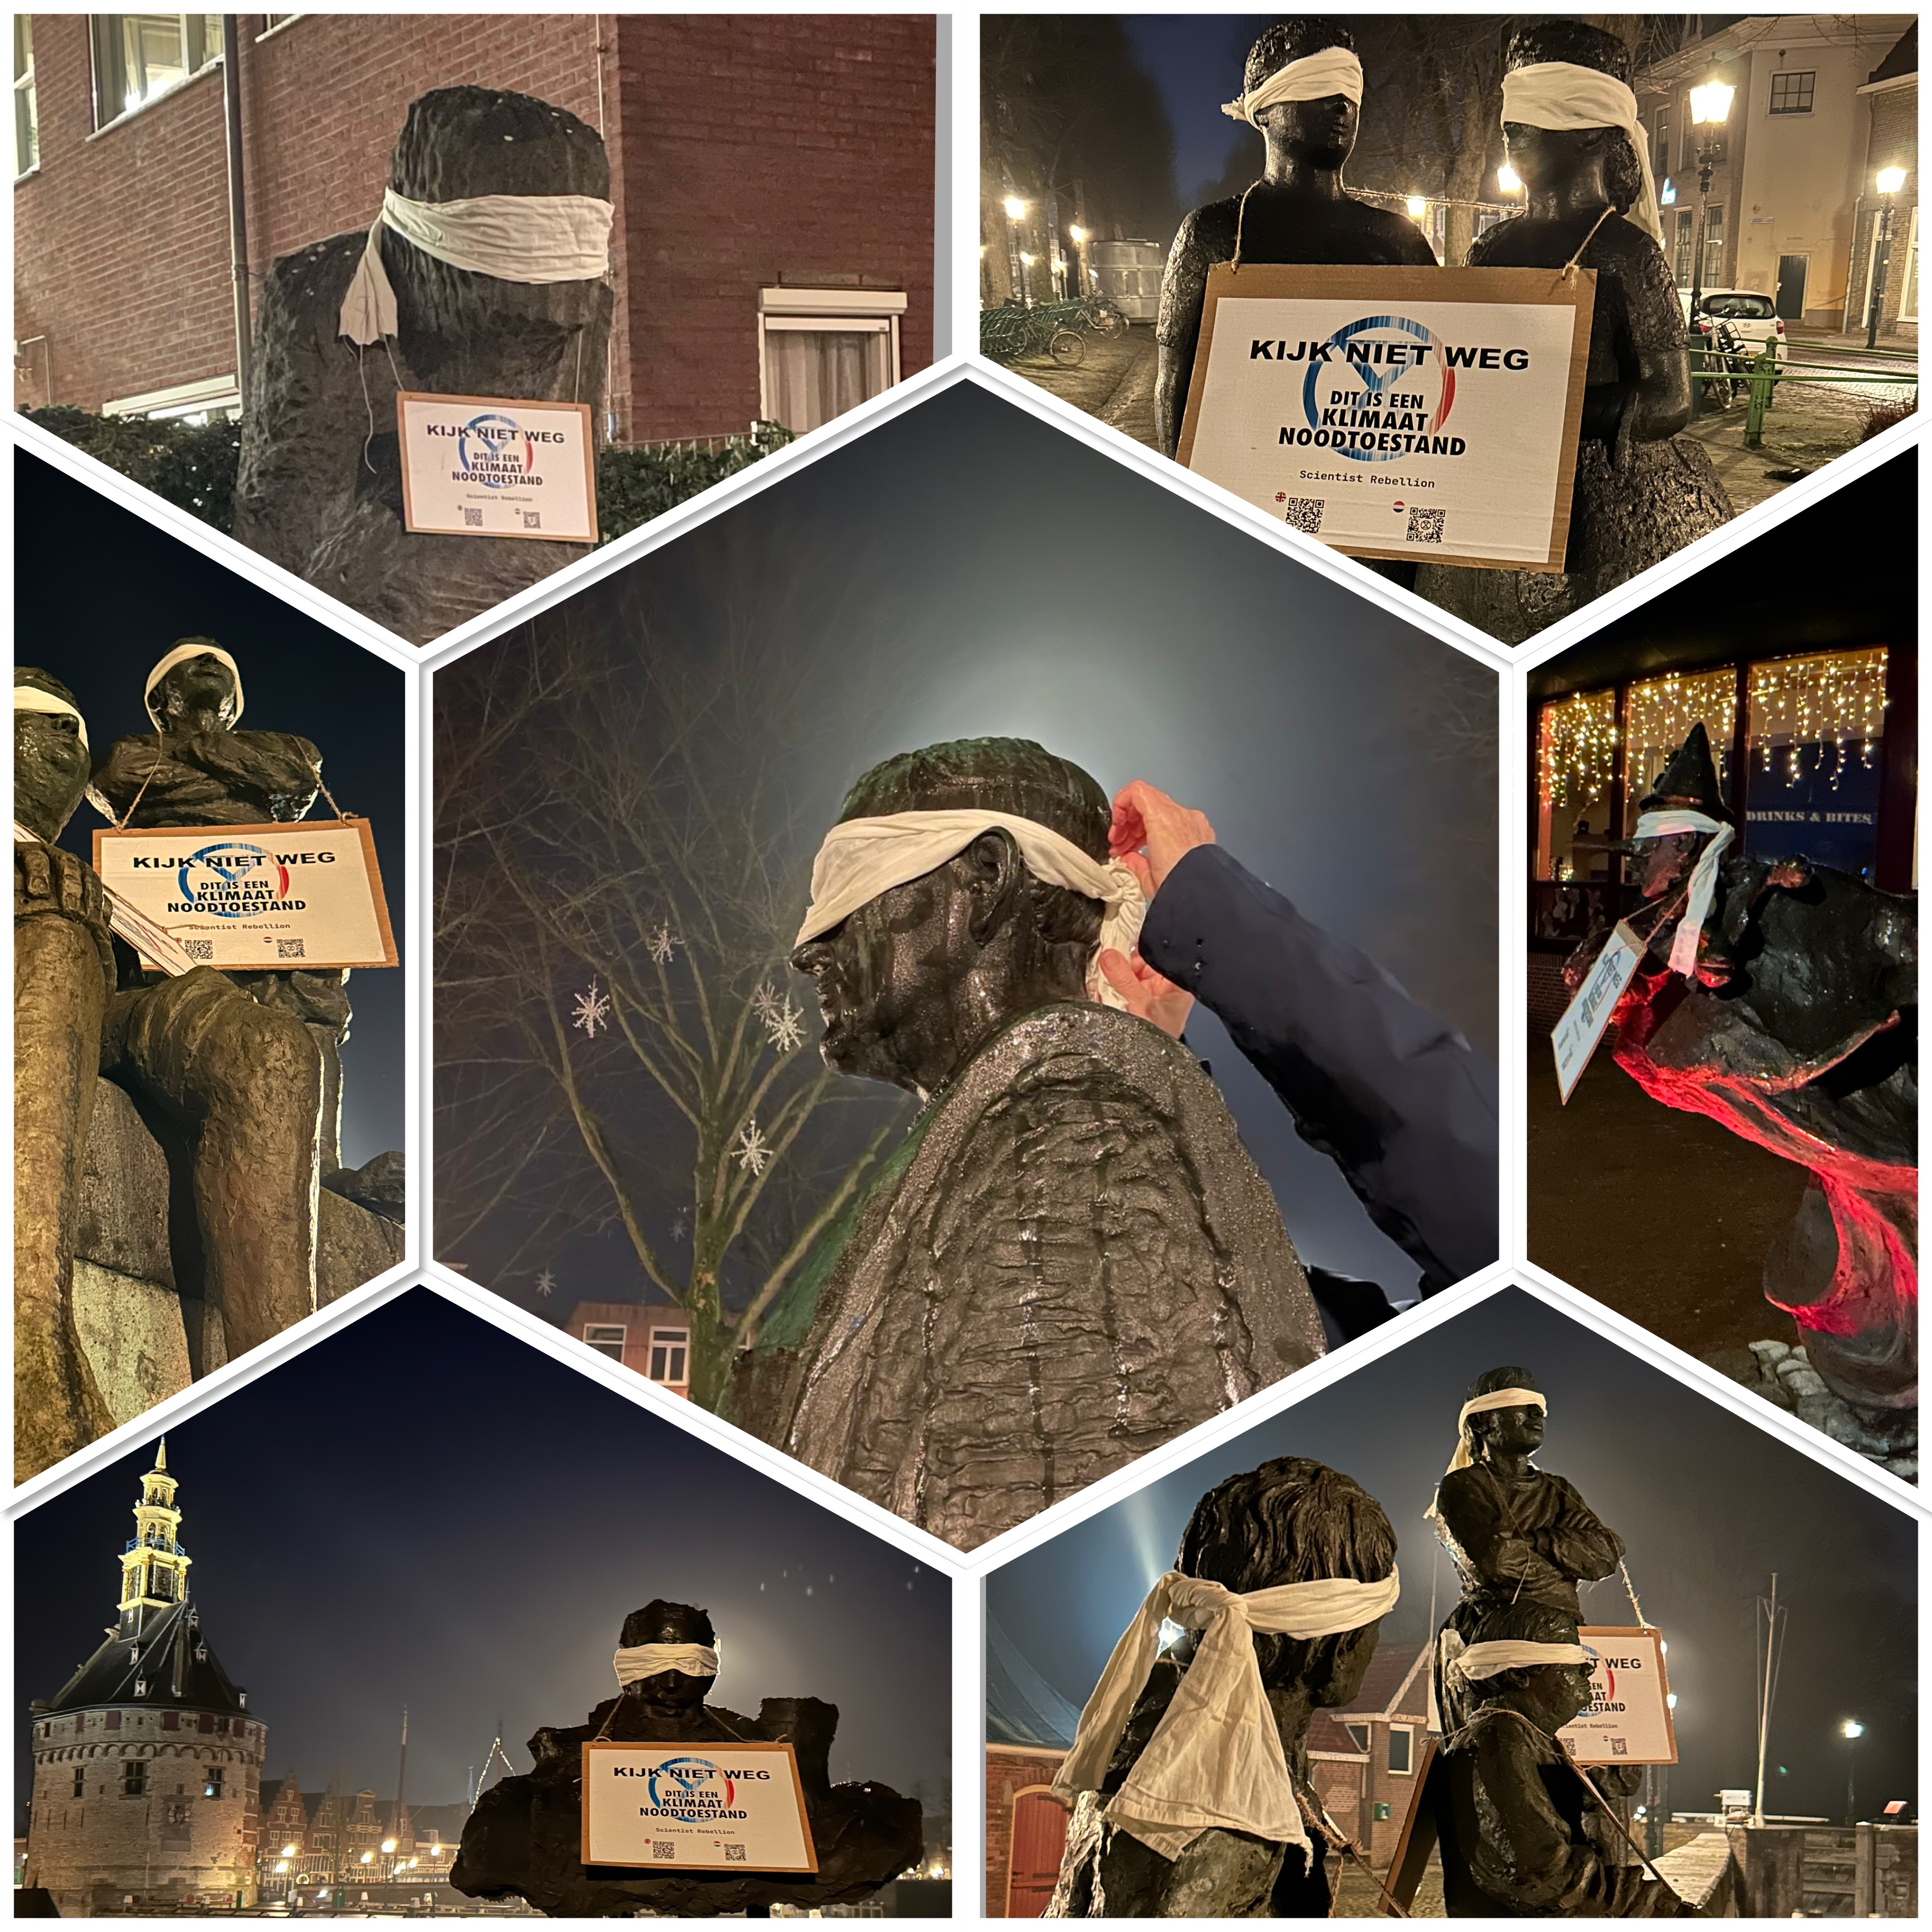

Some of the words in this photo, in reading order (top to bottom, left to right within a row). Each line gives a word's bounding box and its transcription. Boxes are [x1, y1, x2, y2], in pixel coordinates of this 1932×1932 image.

[1250, 340, 1334, 362] KIJK
[1346, 343, 1432, 366] NIET
[1445, 346, 1530, 371] WEG
[1330, 391, 1360, 406] DIT
[1366, 392, 1383, 408] IS
[1390, 394, 1424, 409] EEN
[1322, 409, 1428, 432] KLIMAAT
[427, 425, 471, 438] KIJK
[477, 428, 518, 440] NIET
[525, 431, 565, 443] WEG
[1278, 427, 1466, 456] NOODTOESTAND
[473, 452, 488, 461] DIT
[491, 453, 499, 461] IS
[503, 454, 519, 462] EEN
[472, 462, 523, 473] KLIMAAT
[452, 471, 543, 486] NOODTOESTAND
[1299, 470, 1363, 484] Scientist
[1370, 475, 1435, 489] Rebellion
[1746, 811, 1805, 821] DRINKS
[1810, 812, 1820, 821] &
[1826, 813, 1871, 822] BITES
[133, 857, 196, 868] KIJK
[206, 856, 266, 867] NIET
[276, 852, 336, 865] WEG
[201, 882, 222, 890] DIT
[227, 881, 239, 890] IS
[245, 880, 269, 889] EEN
[197, 890, 274, 901] KLIMAAT
[168, 900, 306, 913] NOODTOESTAND
[1605, 1658, 1641, 1668] WEG
[613, 1767, 662, 1778] KIJK
[670, 1769, 716, 1779] NIET
[725, 1770, 770, 1780] WEG
[663, 1798, 722, 1808] KLIMAAT
[639, 1807, 747, 1819] NOODTOESTAND
